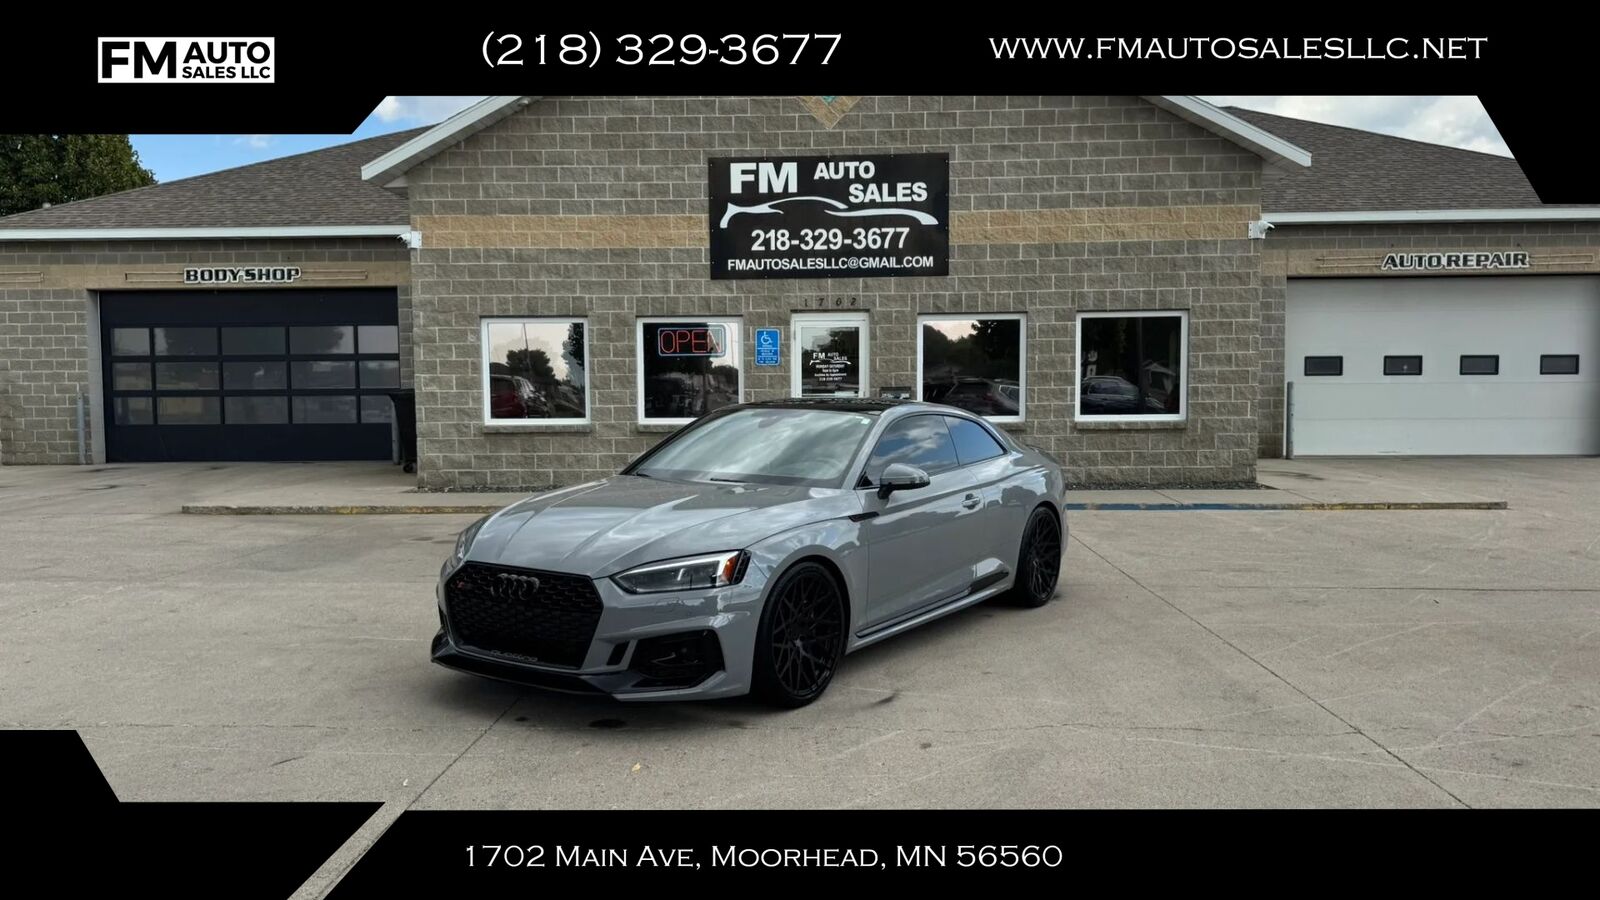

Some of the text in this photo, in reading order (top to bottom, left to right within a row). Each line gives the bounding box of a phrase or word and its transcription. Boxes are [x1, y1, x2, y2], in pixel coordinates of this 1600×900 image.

[730, 161, 875, 194] FM AUTO
[849, 182, 928, 202] SALES
[751, 227, 910, 251] 218-329-3677
[727, 256, 934, 271] FMAUTOSALESLLC@GMAIL.COM
[1382, 252, 1530, 270] AUTO REPAIR
[184, 267, 301, 283] BODY SHOP
[660, 330, 721, 353] OPEN
[812, 352, 826, 360] FM
